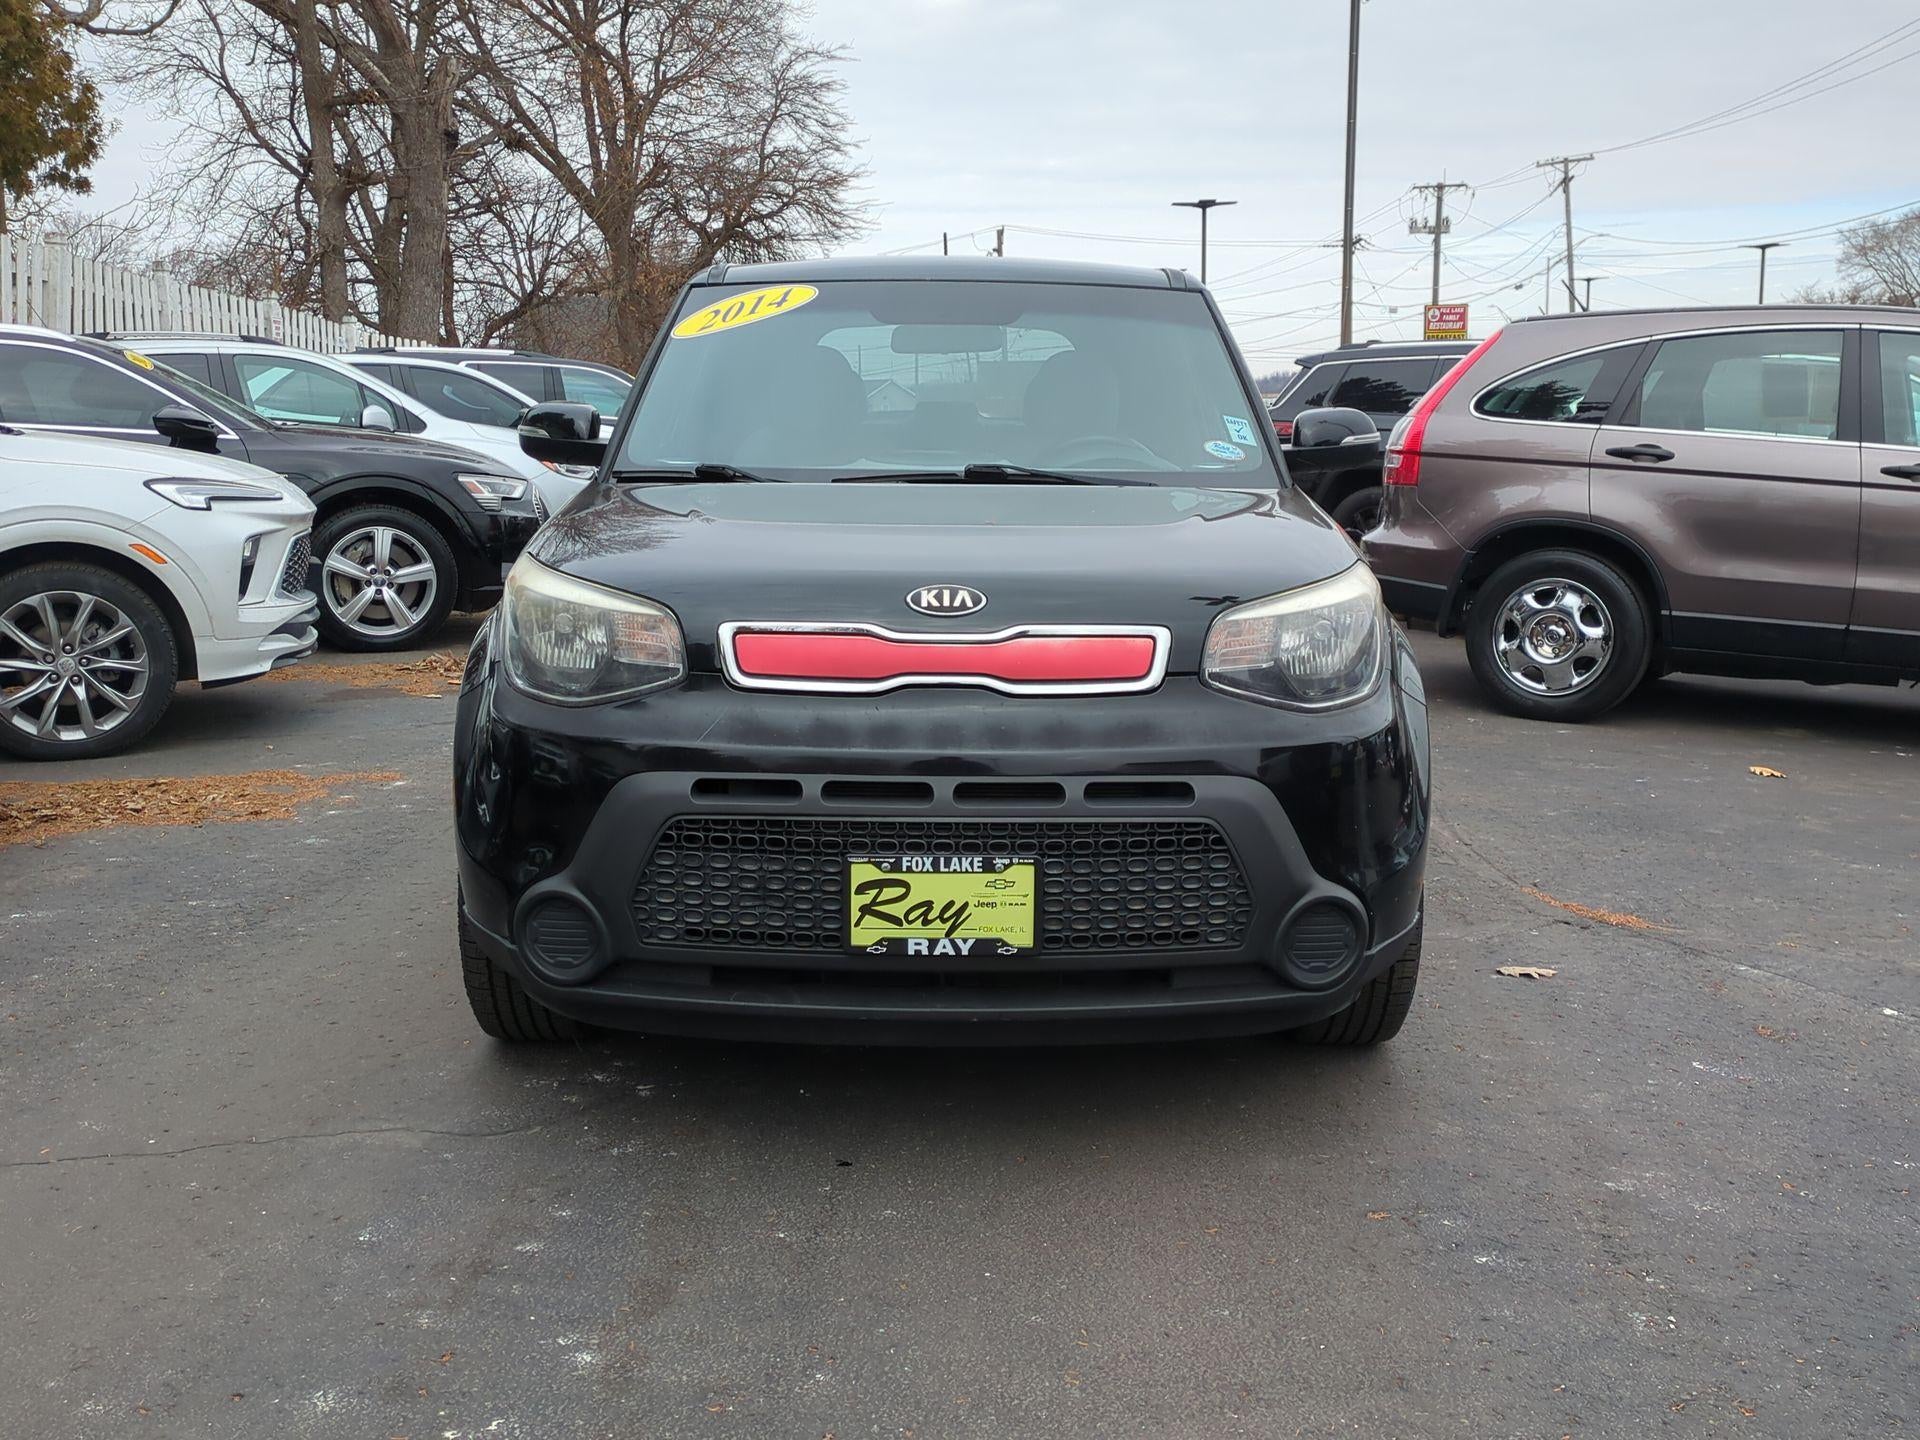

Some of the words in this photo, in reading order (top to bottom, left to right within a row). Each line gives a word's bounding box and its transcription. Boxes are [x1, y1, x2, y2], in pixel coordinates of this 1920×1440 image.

[696, 288, 794, 332] 2014
[1429, 321, 1464, 330] RESTAURANT
[920, 589, 974, 608] KIA
[902, 857, 934, 872] FOX
[940, 857, 983, 872] LAKE
[854, 878, 972, 937] Ray
[974, 900, 997, 909] Jeep
[978, 925, 993, 933] FOX
[907, 938, 976, 956] RAY
